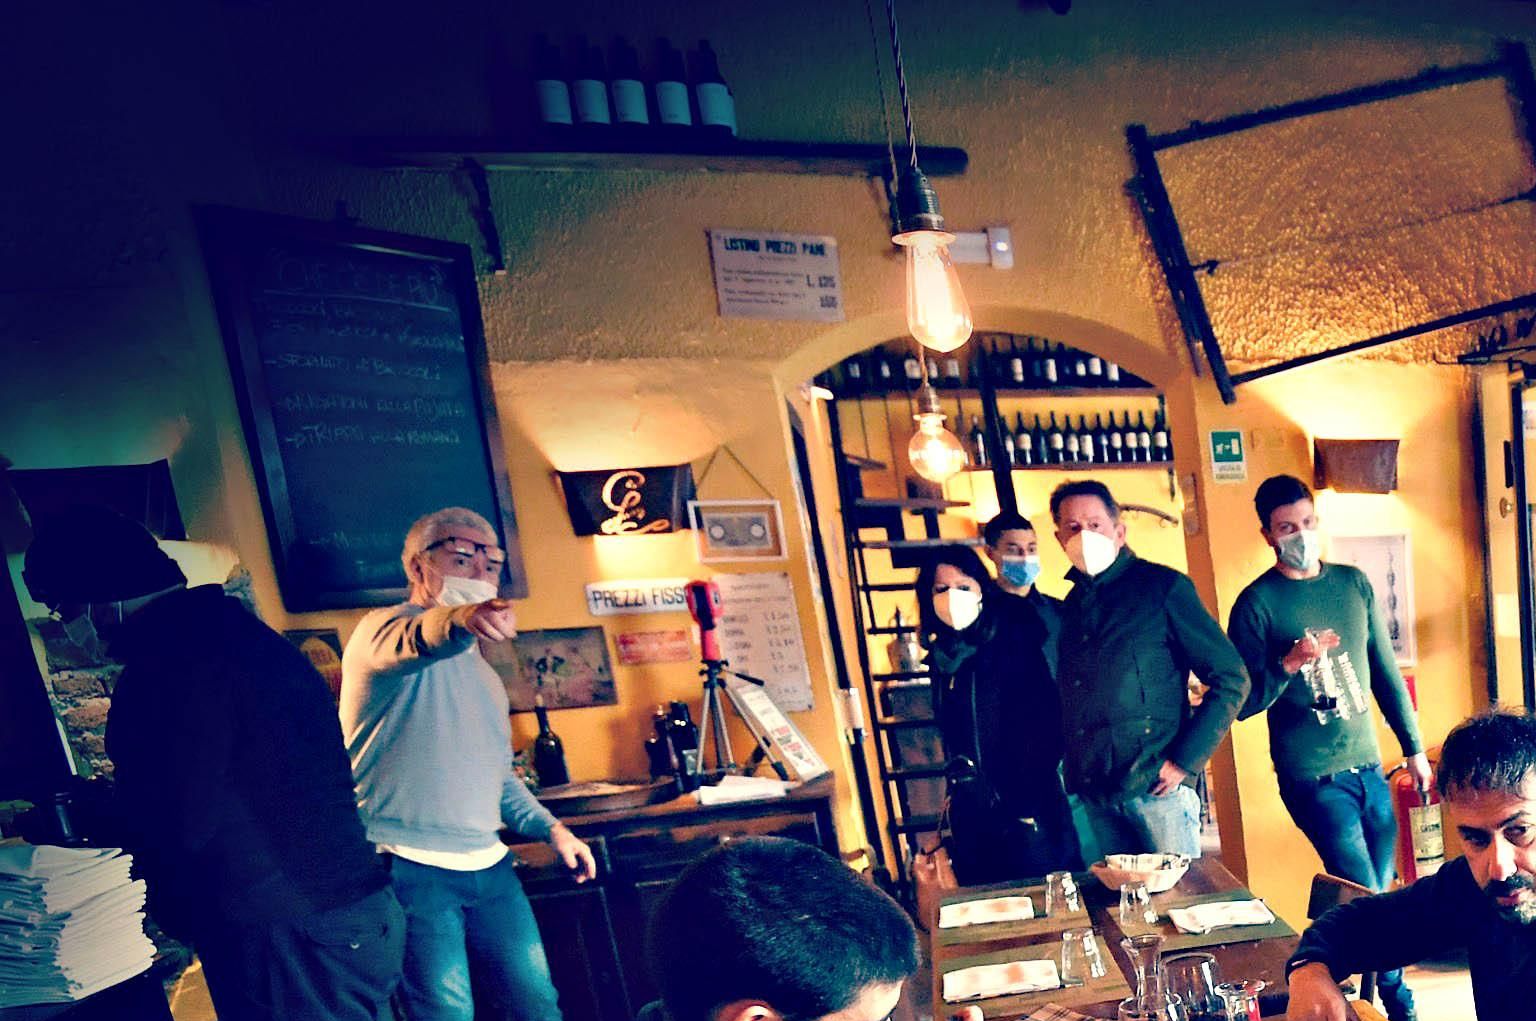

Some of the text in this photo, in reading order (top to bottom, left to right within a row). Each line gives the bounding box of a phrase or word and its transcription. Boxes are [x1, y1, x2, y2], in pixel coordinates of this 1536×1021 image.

[724, 238, 760, 252] LISTINO
[765, 240, 797, 255] PREZZI
[591, 585, 685, 609] PREZZI FISS
